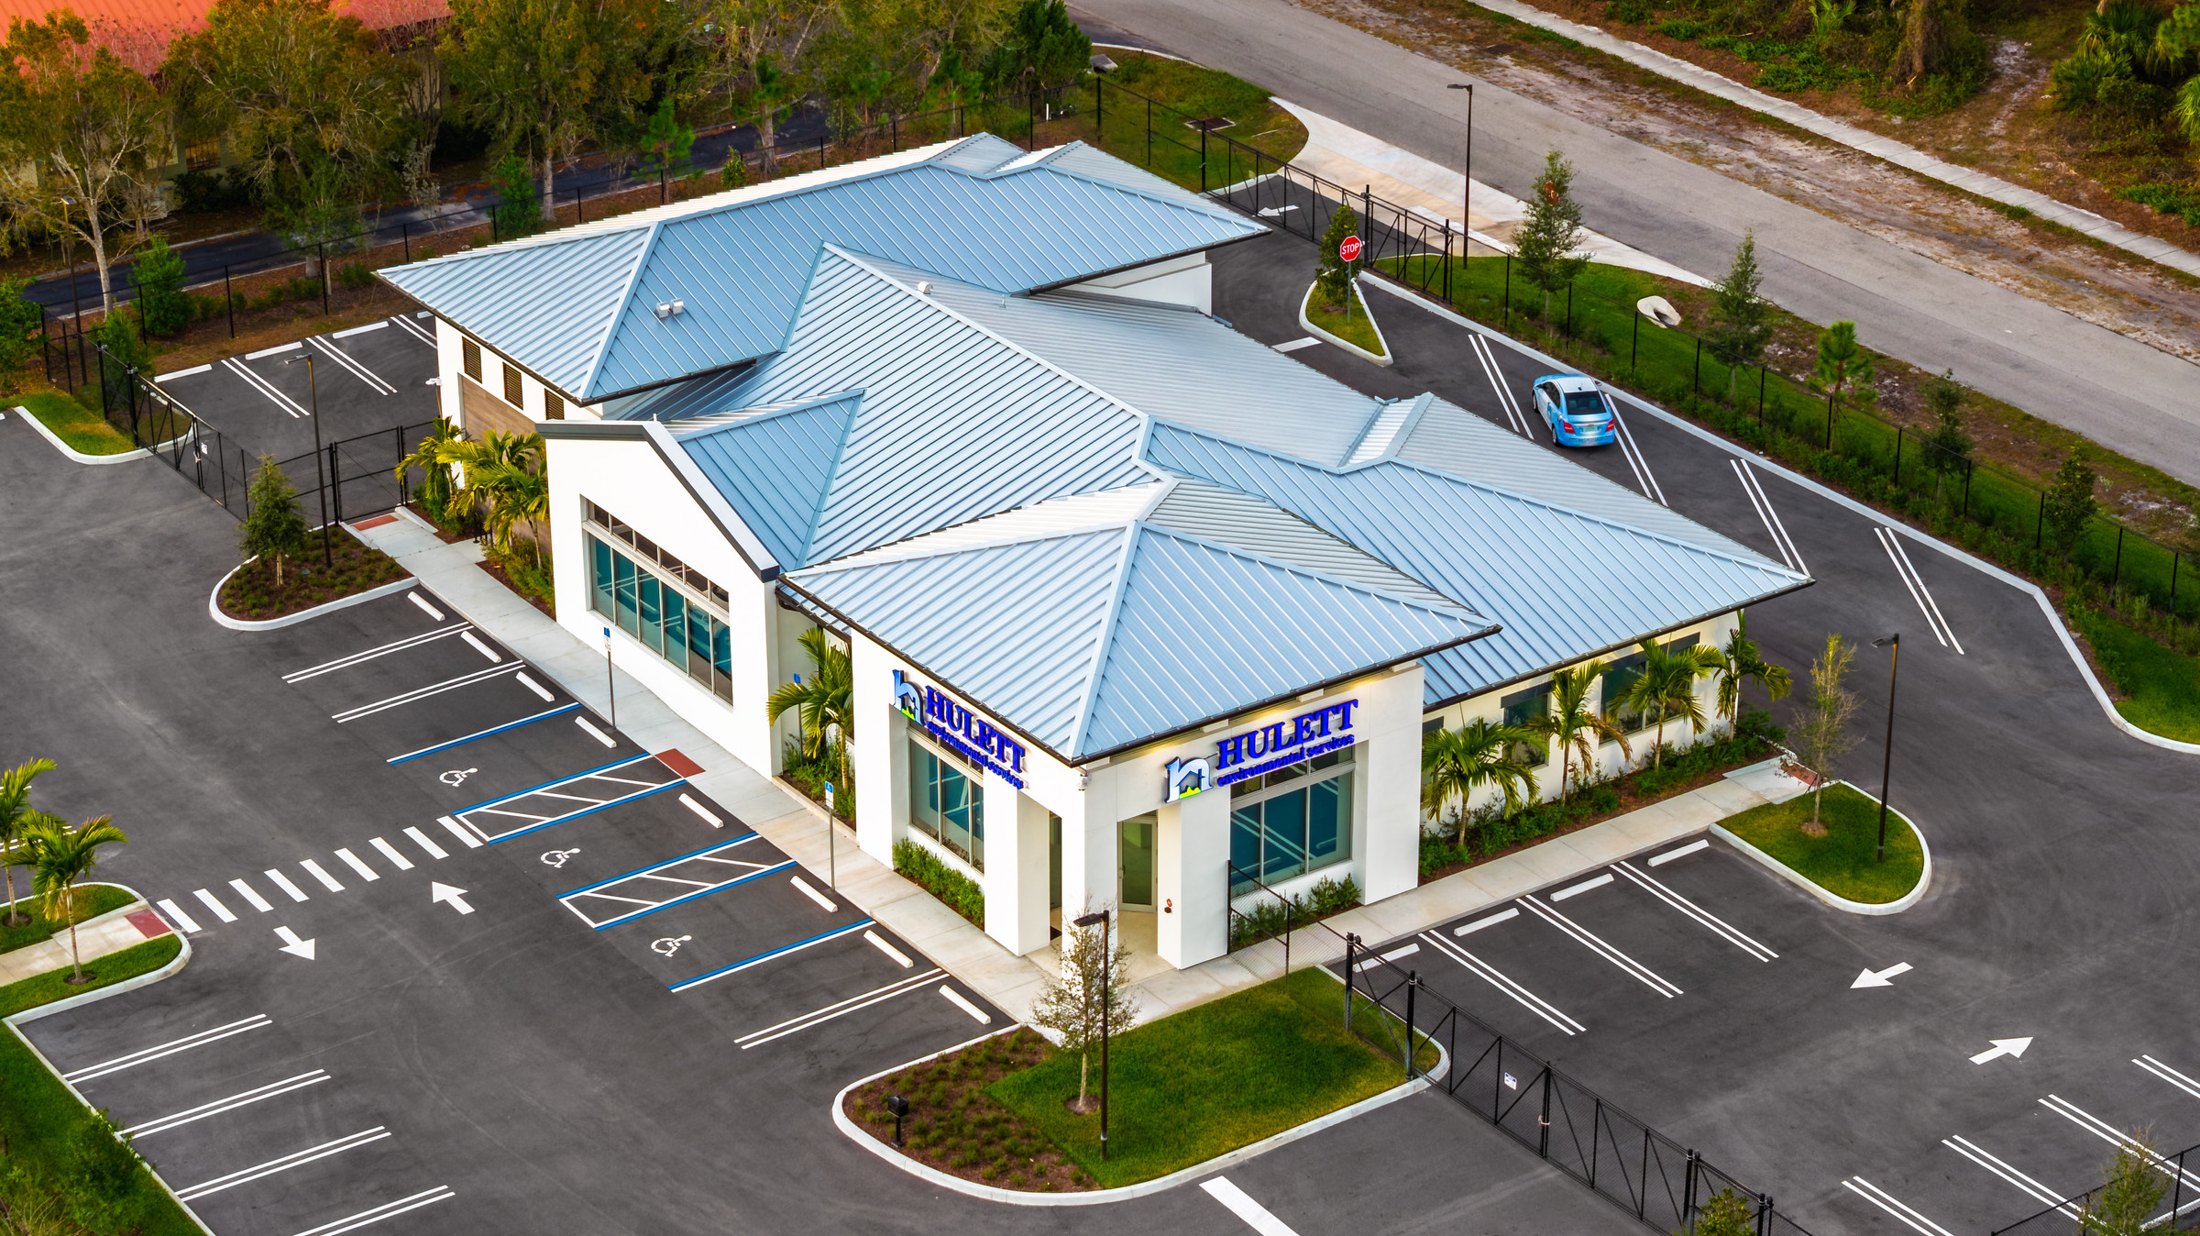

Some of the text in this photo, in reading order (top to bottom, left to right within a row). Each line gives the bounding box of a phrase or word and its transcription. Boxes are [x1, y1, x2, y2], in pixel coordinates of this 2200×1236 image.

[1342, 243, 1359, 254] STOP
[925, 685, 1026, 773] HULETT
[1216, 699, 1359, 770] HULETT
[1216, 733, 1355, 787] environmental services
